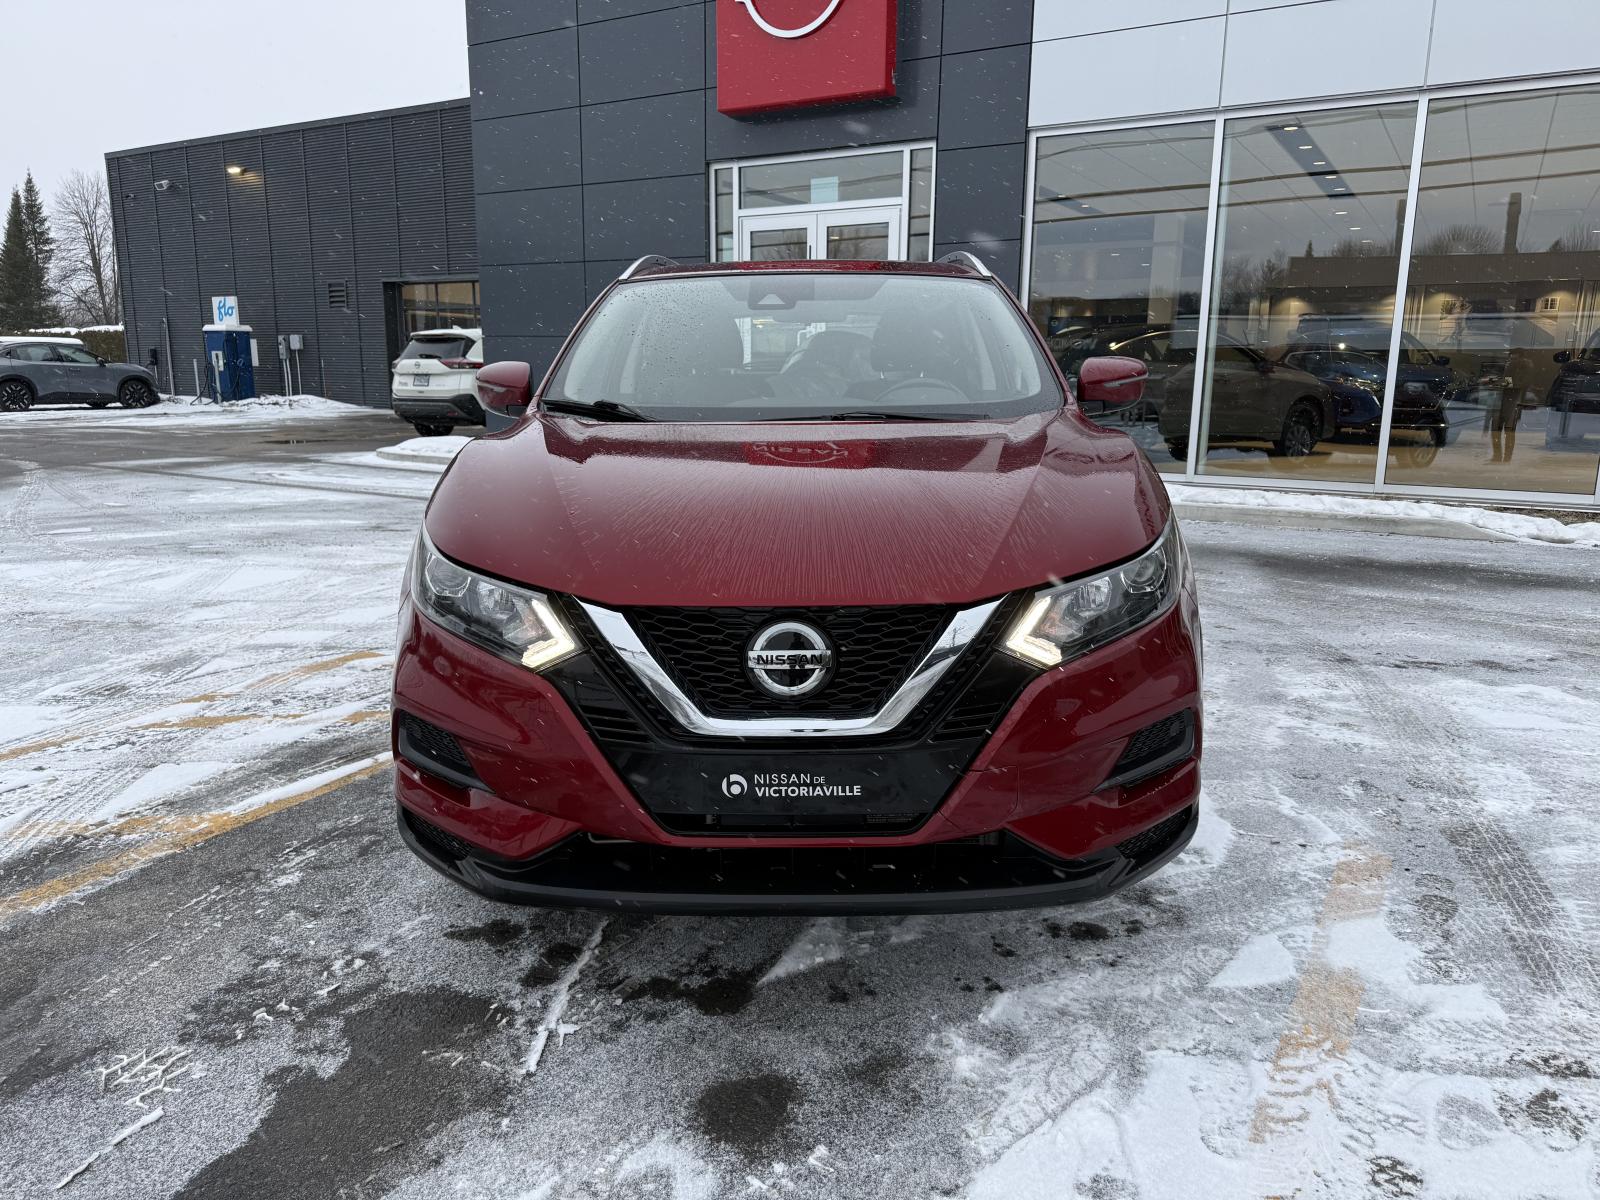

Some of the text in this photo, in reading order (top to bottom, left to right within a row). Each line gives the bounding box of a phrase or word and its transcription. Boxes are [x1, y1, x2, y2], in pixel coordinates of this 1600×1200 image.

[217, 297, 235, 321] flo
[756, 653, 822, 666] NISSAN
[754, 773, 826, 785] NISSAN DE
[755, 785, 862, 797] VICTORIAVILLE
